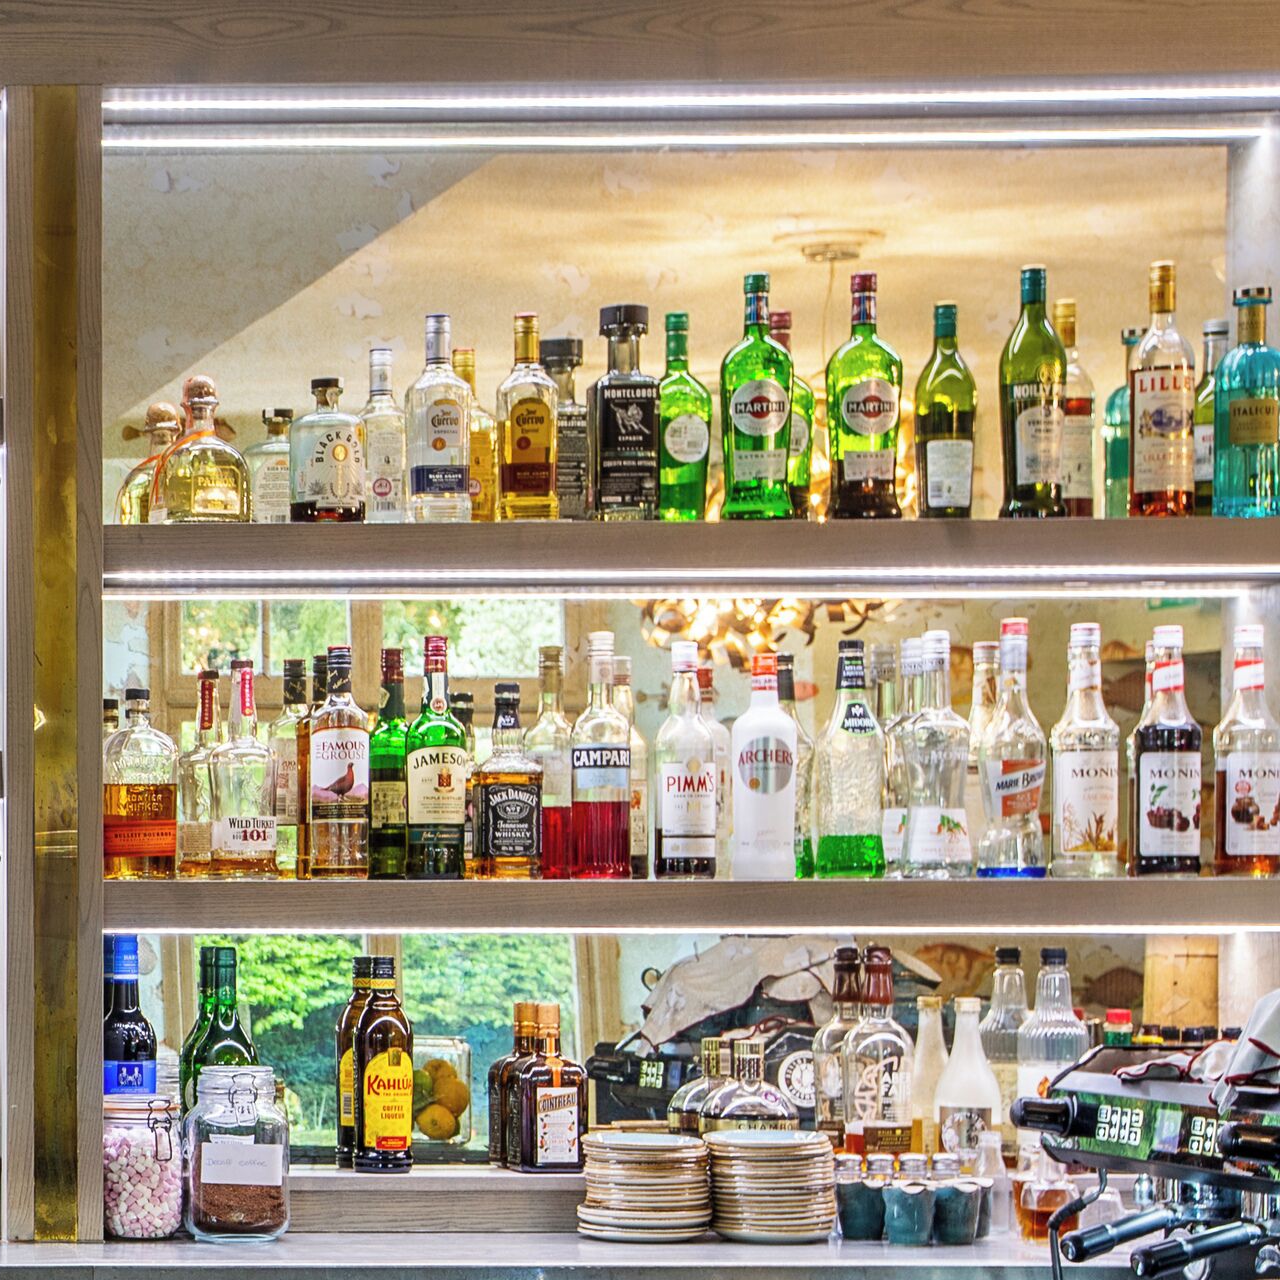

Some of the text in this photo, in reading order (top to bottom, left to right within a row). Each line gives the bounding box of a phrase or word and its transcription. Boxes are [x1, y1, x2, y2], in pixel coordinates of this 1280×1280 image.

[604, 388, 657, 399] MONTELOBOS
[736, 401, 784, 413] MARTINI
[848, 402, 895, 413] MARTINI
[844, 718, 874, 728] MIDORI
[321, 740, 366, 751] FAMOUS
[321, 751, 365, 760] GROUSE
[573, 750, 630, 767] CAMPARI
[738, 750, 794, 767] ARCHERS
[666, 771, 715, 793] PIMM'S
[996, 777, 1019, 790] MARIE
[489, 788, 538, 807] JACK DANIEL'S
[228, 817, 252, 828] WILD
[242, 829, 267, 842] 101
